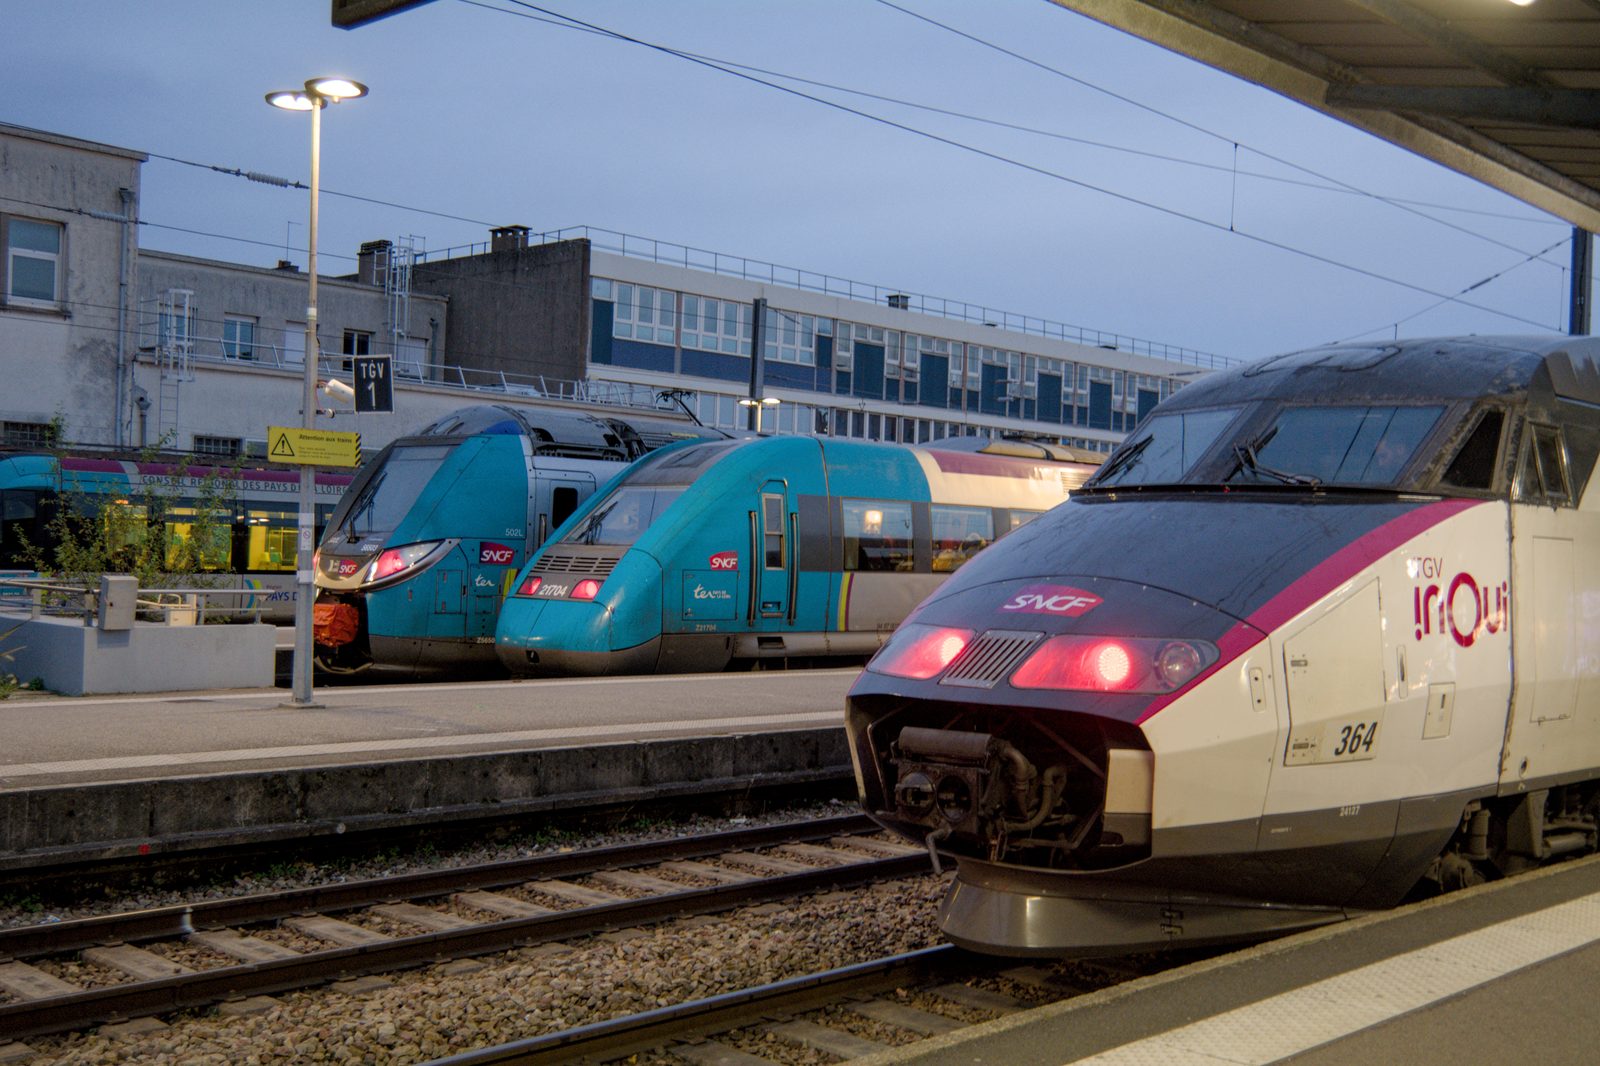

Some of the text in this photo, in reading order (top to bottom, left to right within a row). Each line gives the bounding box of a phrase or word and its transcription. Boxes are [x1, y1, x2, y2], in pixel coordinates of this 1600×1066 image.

[360, 363, 384, 379] TGV
[367, 382, 376, 410] 1
[299, 433, 325, 442] Attention
[243, 480, 261, 491] DES
[264, 482, 288, 492] PAYS
[505, 528, 523, 537] 502L
[480, 549, 513, 562] SNCF
[339, 564, 358, 574] SNCF
[711, 557, 738, 569] SNCF
[475, 573, 495, 587] ter
[539, 584, 568, 597] 21704
[694, 584, 716, 599] ter
[1003, 594, 1097, 611] SNCF
[1334, 721, 1378, 756] 364
